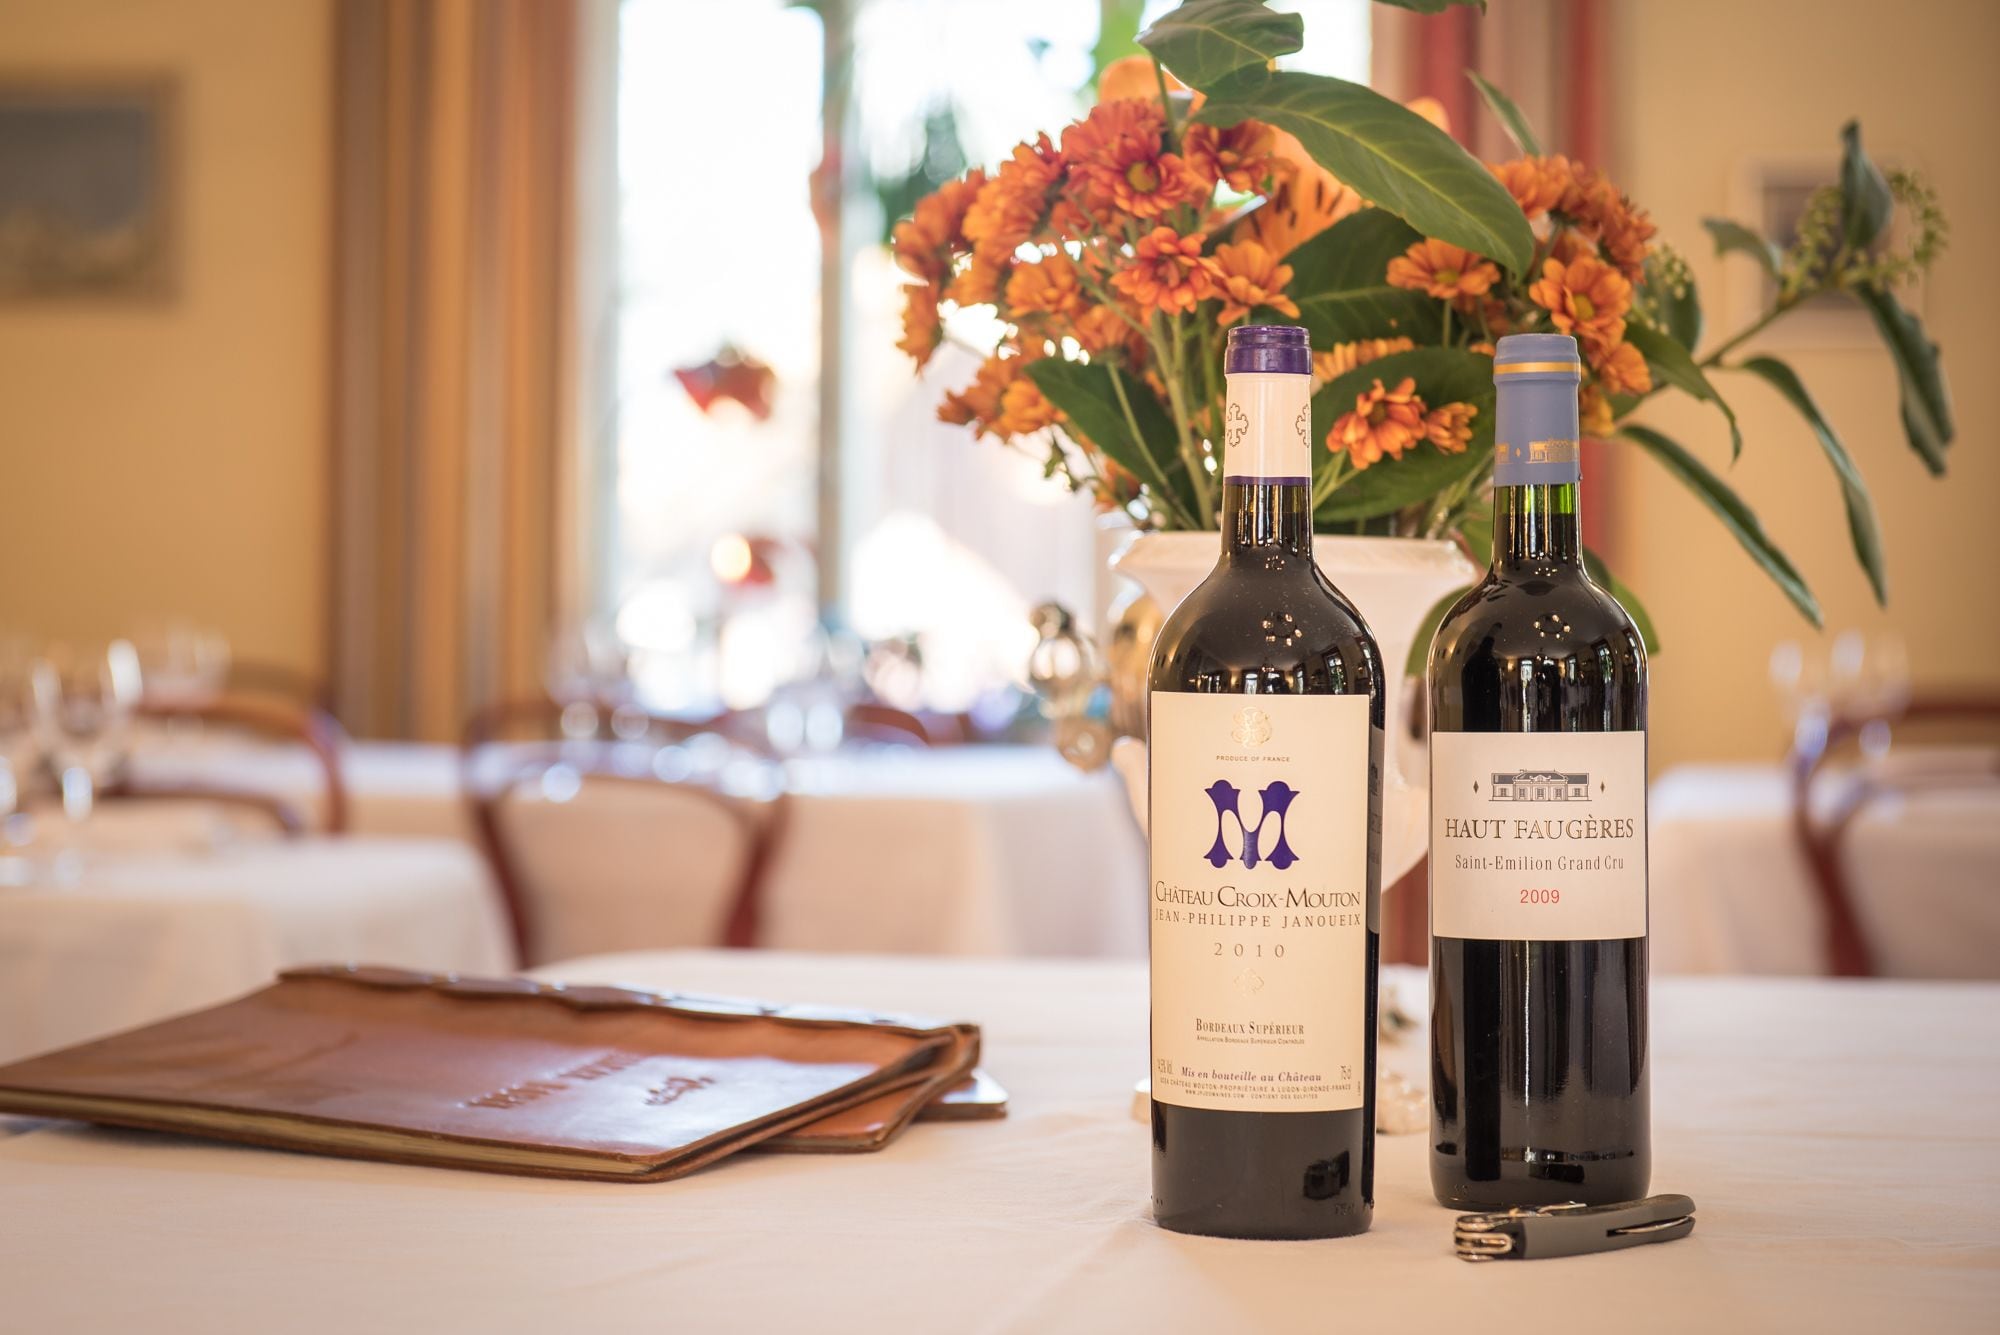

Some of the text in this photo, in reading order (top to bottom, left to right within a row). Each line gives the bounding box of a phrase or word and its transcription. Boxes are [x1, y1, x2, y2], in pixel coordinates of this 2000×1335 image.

[1445, 814, 1635, 840] HAUT FAUGÈRES
[1455, 855, 1624, 871] Saint-Emilion Grand Cru
[1155, 880, 1361, 909] CHÂTEAU CROIX-MOUTON
[1520, 889, 1560, 904] 2009
[1155, 908, 1361, 929] JEAN-PHILIPPE JANOUEIX
[1214, 942, 1285, 958] 2010
[1196, 1018, 1304, 1035] BORDEAUX SUPÉRIEUR
[1182, 1066, 1195, 1077] Mis
[1197, 1071, 1208, 1079] en
[1211, 1069, 1257, 1081] bouteille
[1260, 1073, 1274, 1082] au
[1278, 1071, 1322, 1082] Château
